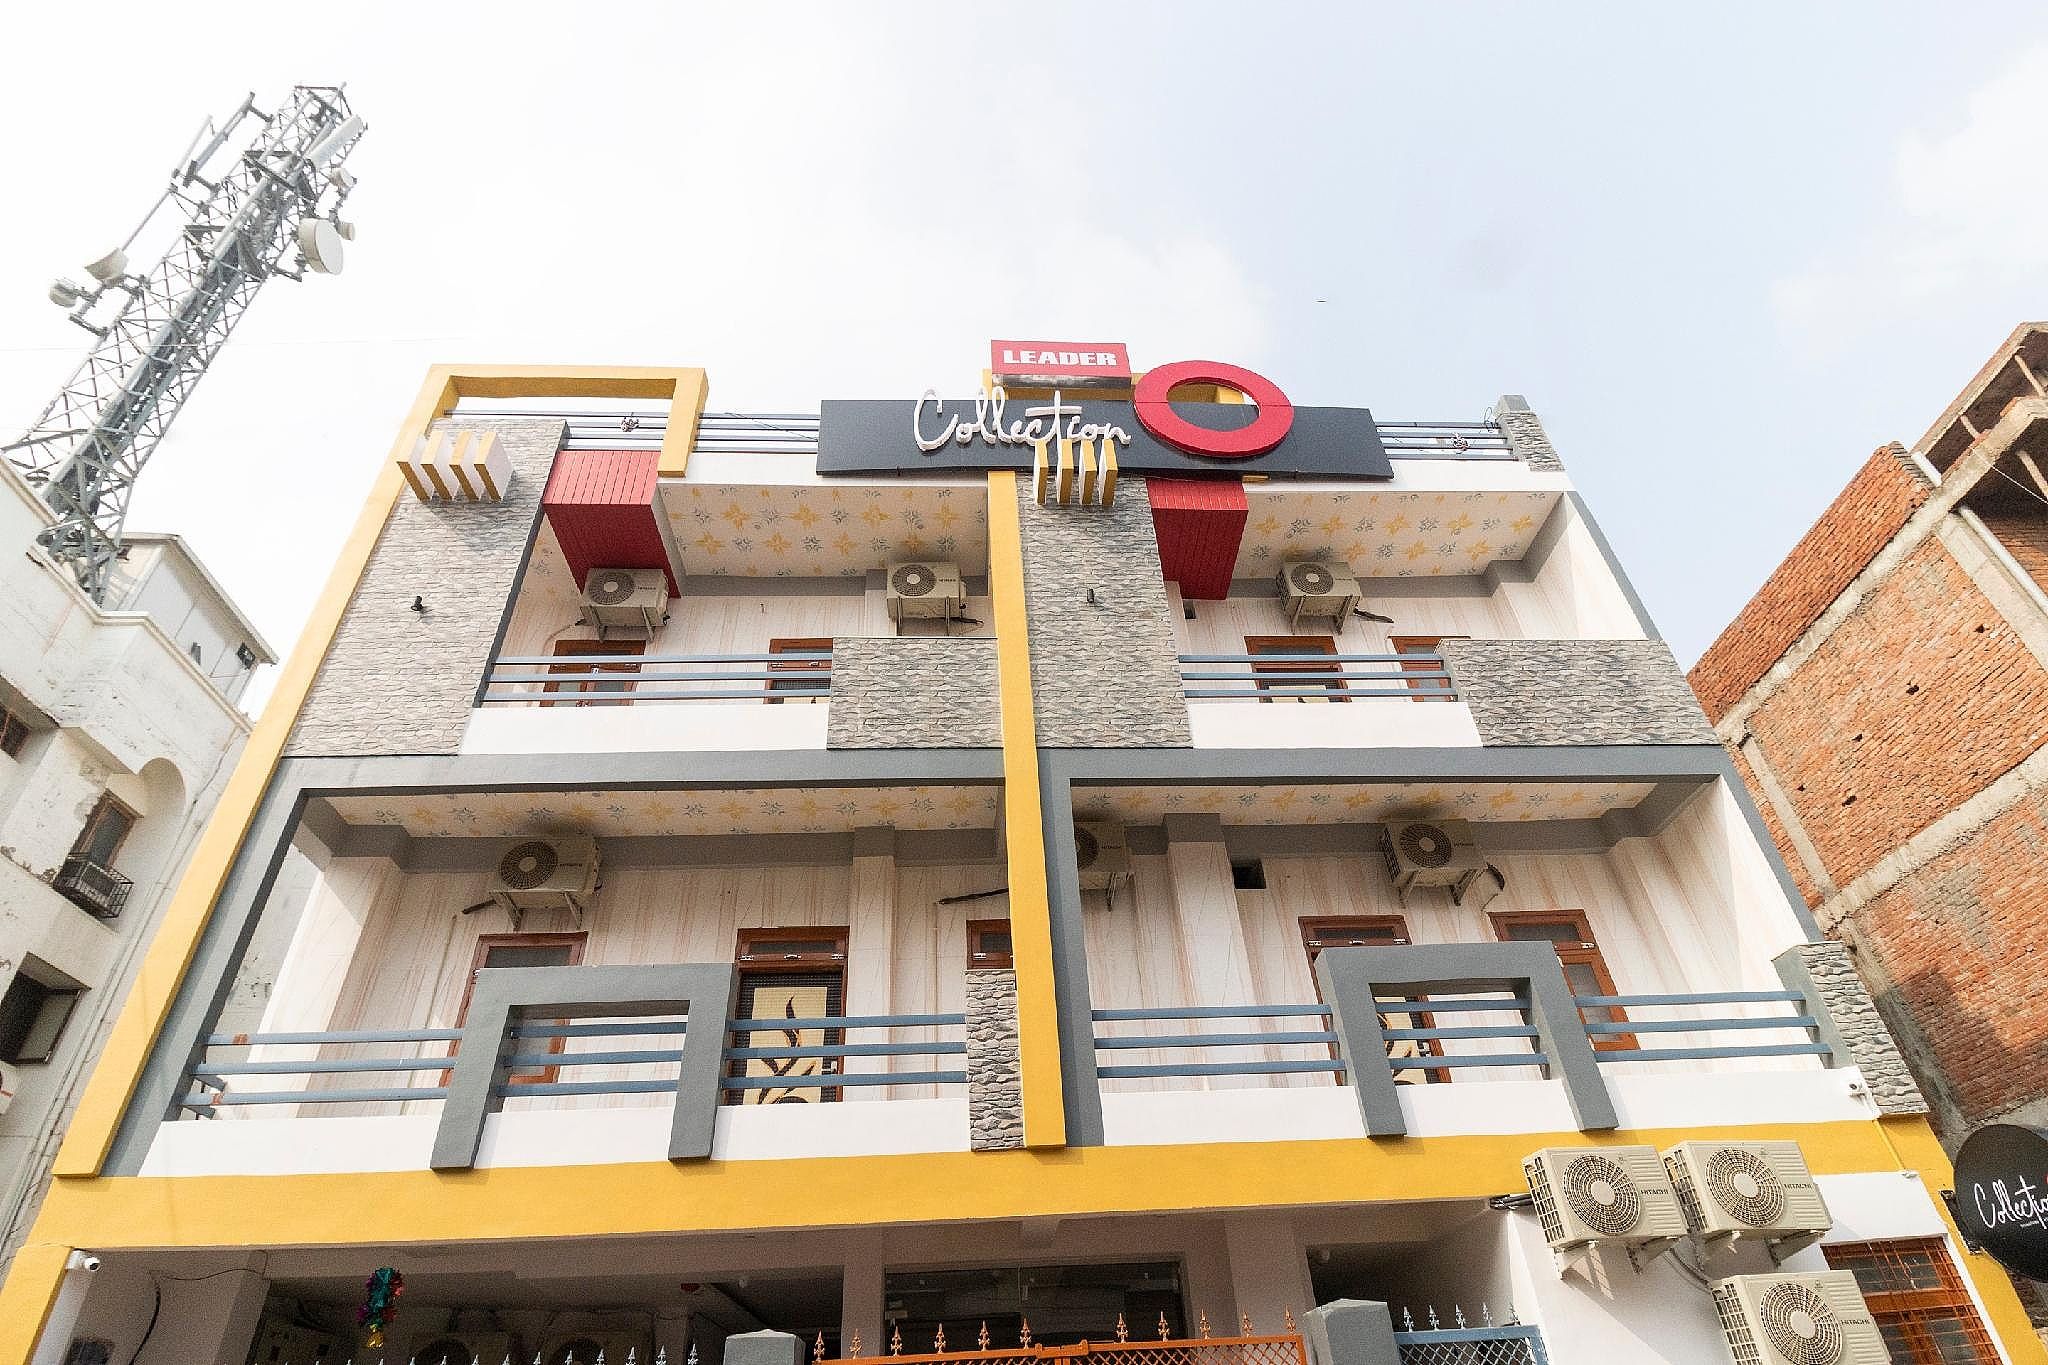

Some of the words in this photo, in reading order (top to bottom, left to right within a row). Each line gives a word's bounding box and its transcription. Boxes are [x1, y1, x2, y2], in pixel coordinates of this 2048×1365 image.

[1002, 349, 1117, 366] LEADER
[913, 388, 1132, 451] Collection
[1973, 1174, 2048, 1230] Collectio
